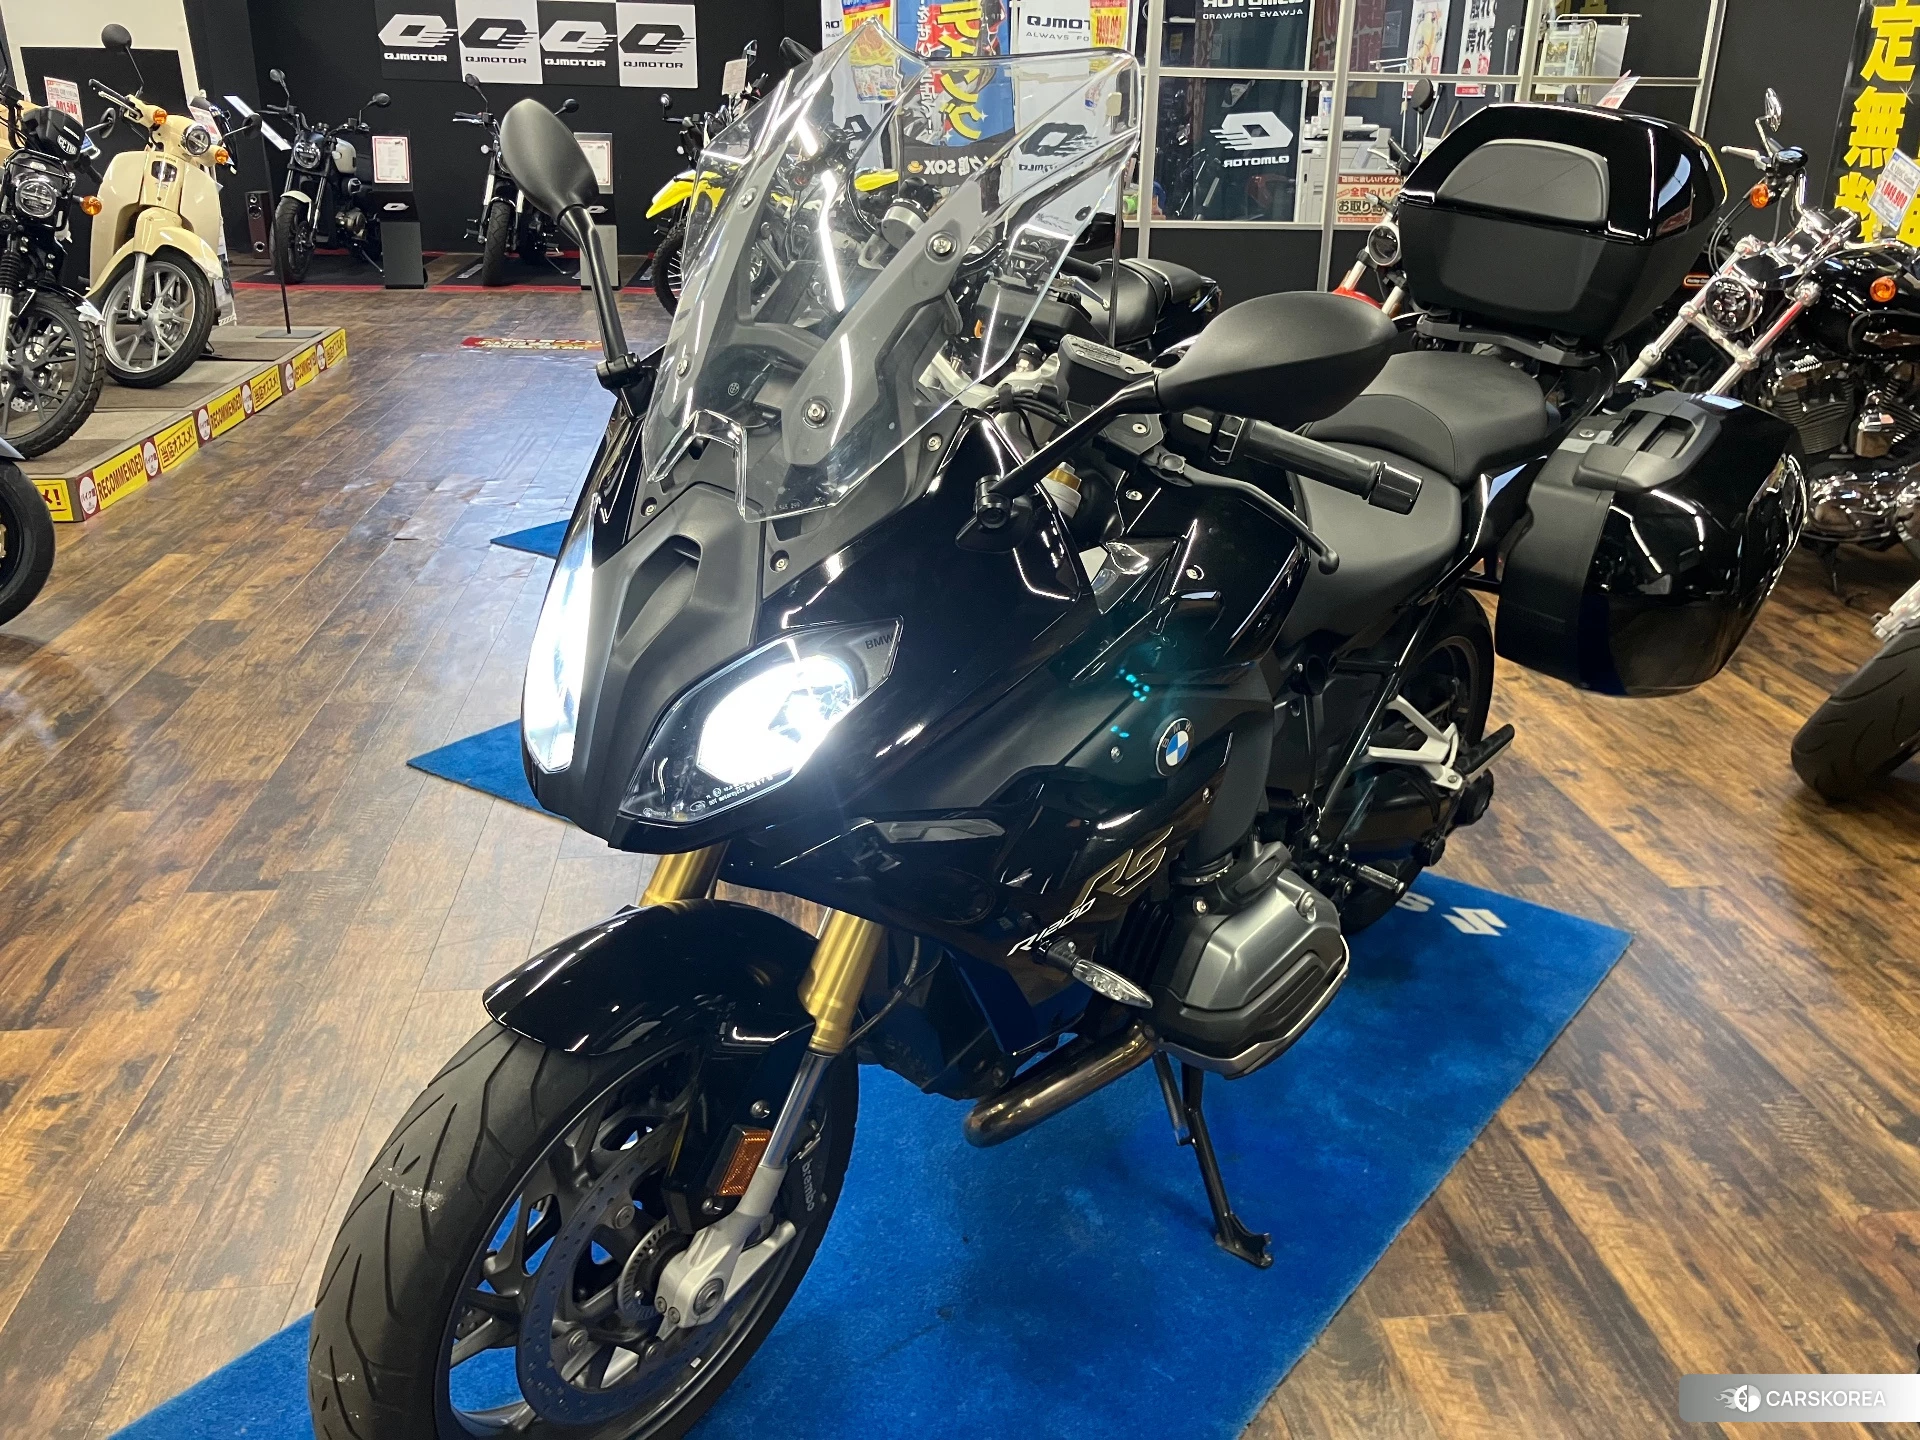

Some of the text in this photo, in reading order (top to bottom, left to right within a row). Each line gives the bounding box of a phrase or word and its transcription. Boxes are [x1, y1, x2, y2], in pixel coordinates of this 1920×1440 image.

[384, 52, 447, 62] QJMOTOR
[465, 55, 527, 64] QJMOTOR
[544, 58, 606, 67] QJMOTOR
[623, 61, 684, 69] QJMOTOR
[97, 452, 144, 502] RECOMMENDED
[865, 633, 895, 650] BMW
[1161, 719, 1193, 749] BMW
[1070, 826, 1174, 909] RS
[801, 1158, 815, 1212] brembo
